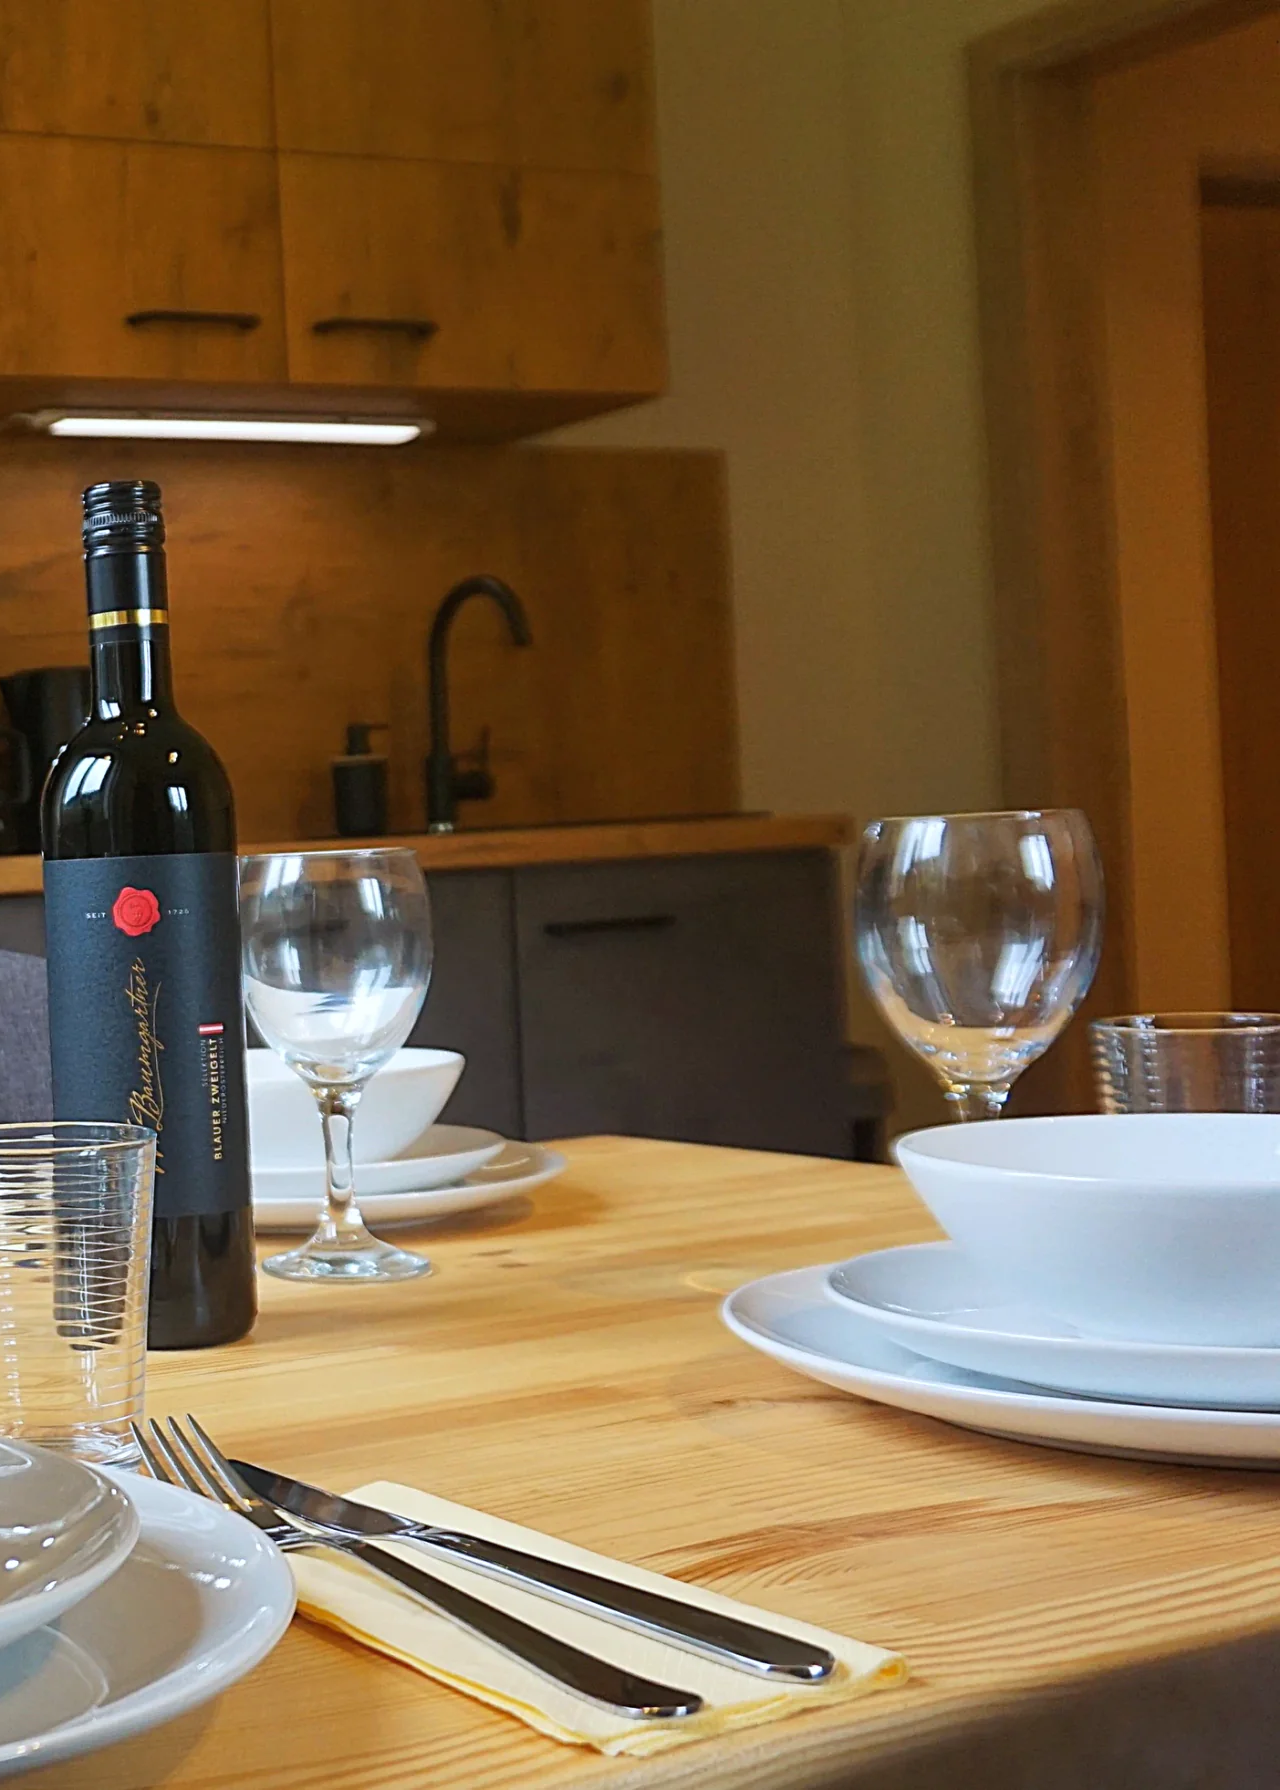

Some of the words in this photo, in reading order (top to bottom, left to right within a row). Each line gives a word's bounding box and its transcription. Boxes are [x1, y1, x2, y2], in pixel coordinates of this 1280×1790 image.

[125, 957, 164, 1125] Baumgartner
[210, 1038, 221, 1104] ZWEIGELT
[212, 1110, 223, 1160] BLAUER
